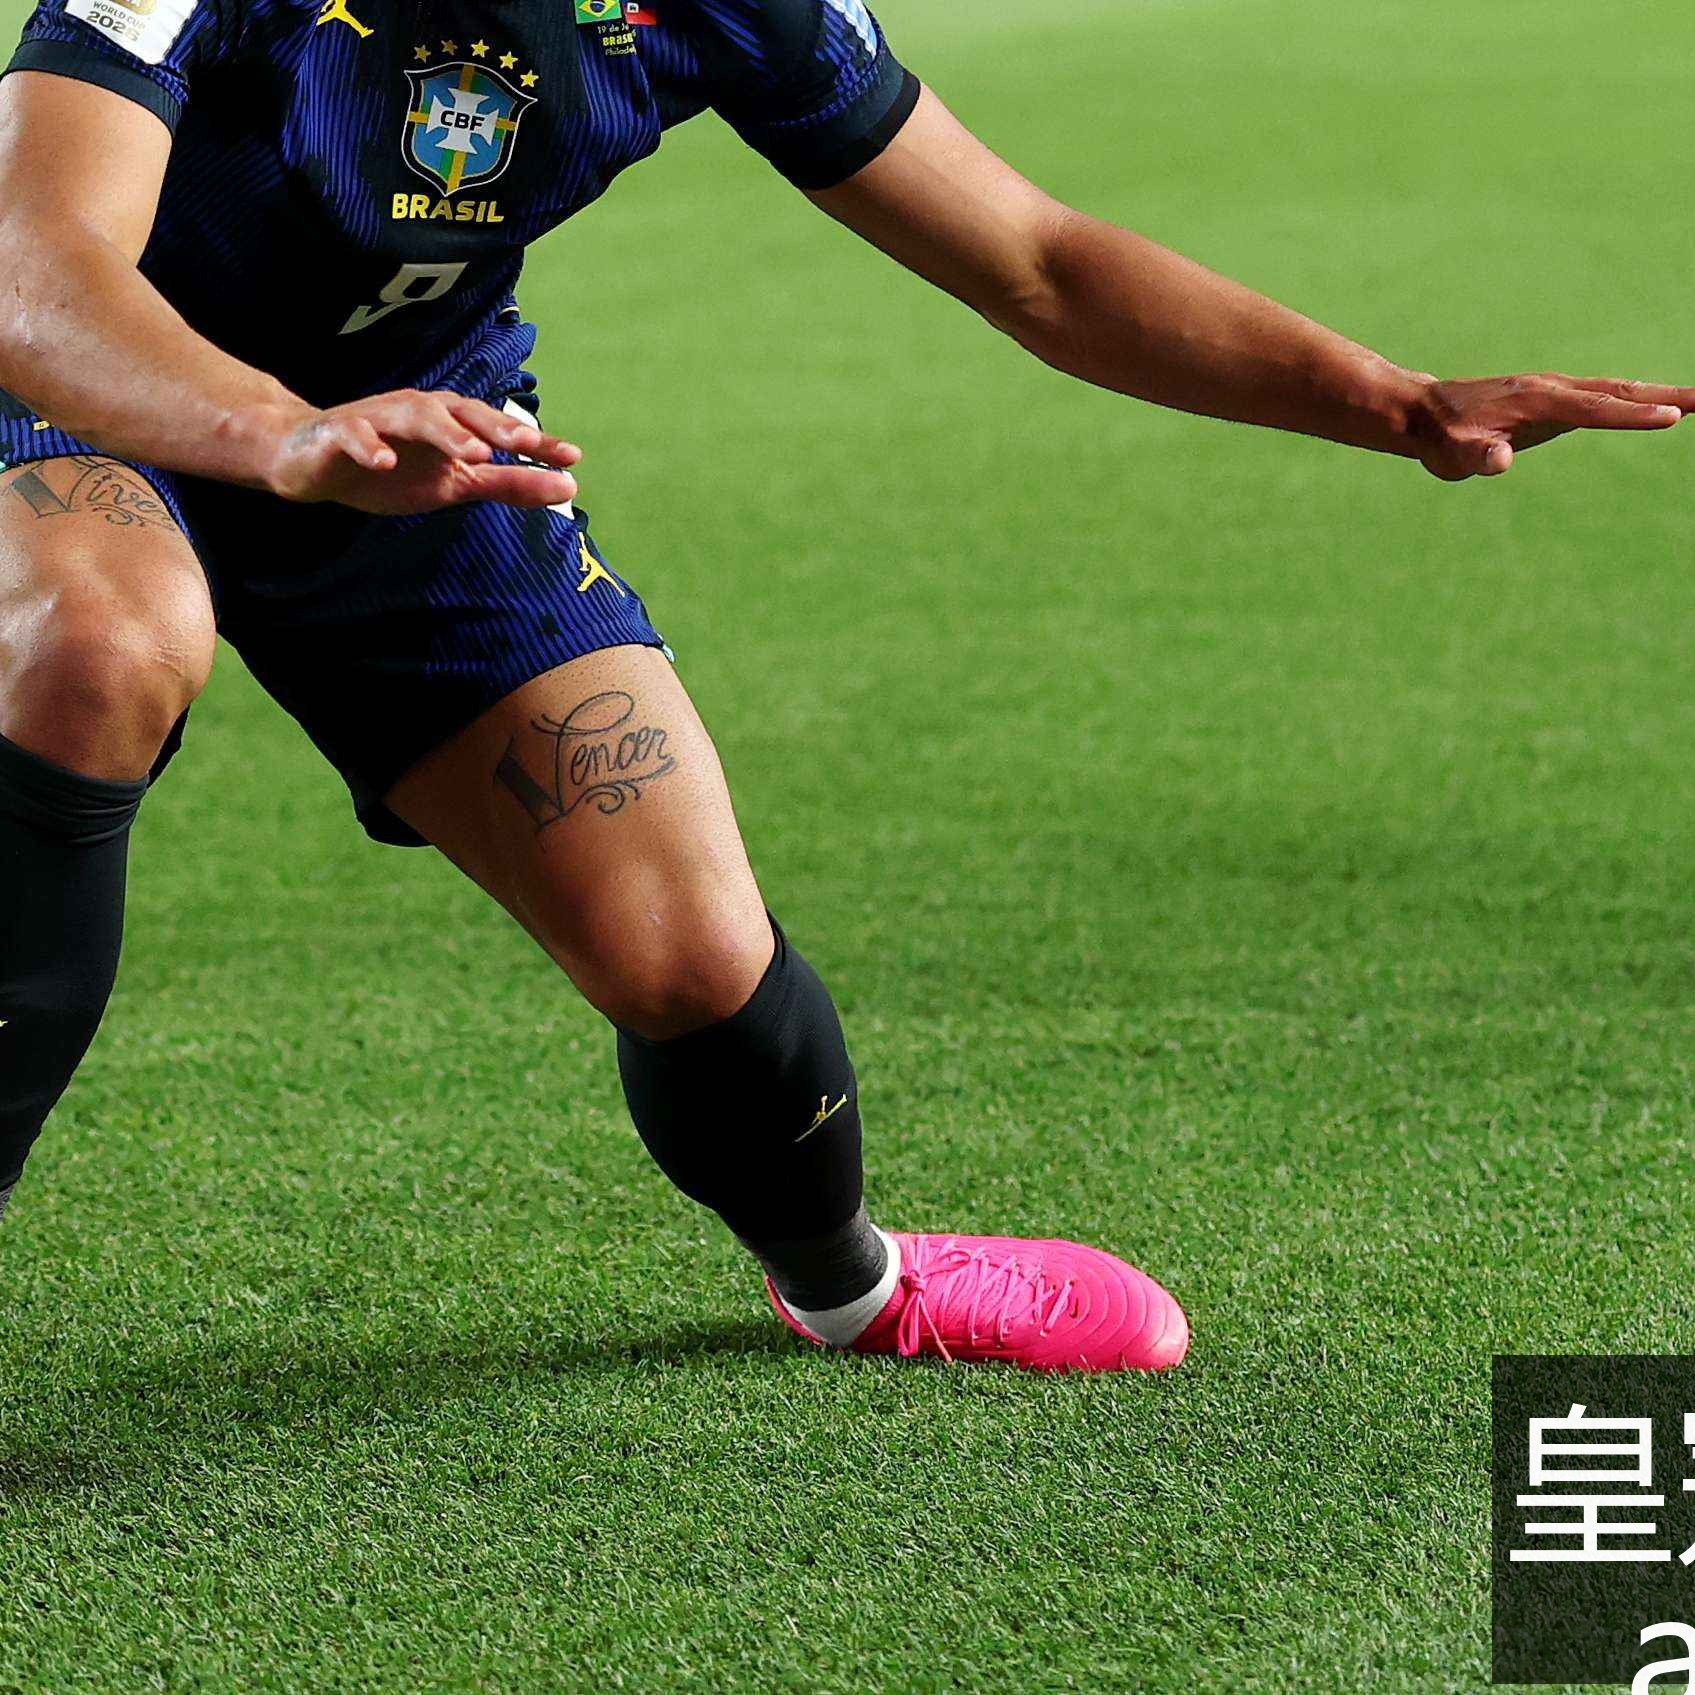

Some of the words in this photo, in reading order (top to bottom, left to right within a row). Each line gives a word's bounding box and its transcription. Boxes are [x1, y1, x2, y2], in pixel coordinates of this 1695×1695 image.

[93, 0, 126, 21] WORLD
[440, 110, 486, 131] CBF
[391, 193, 505, 223] BRASIL
[337, 261, 471, 335] 9
